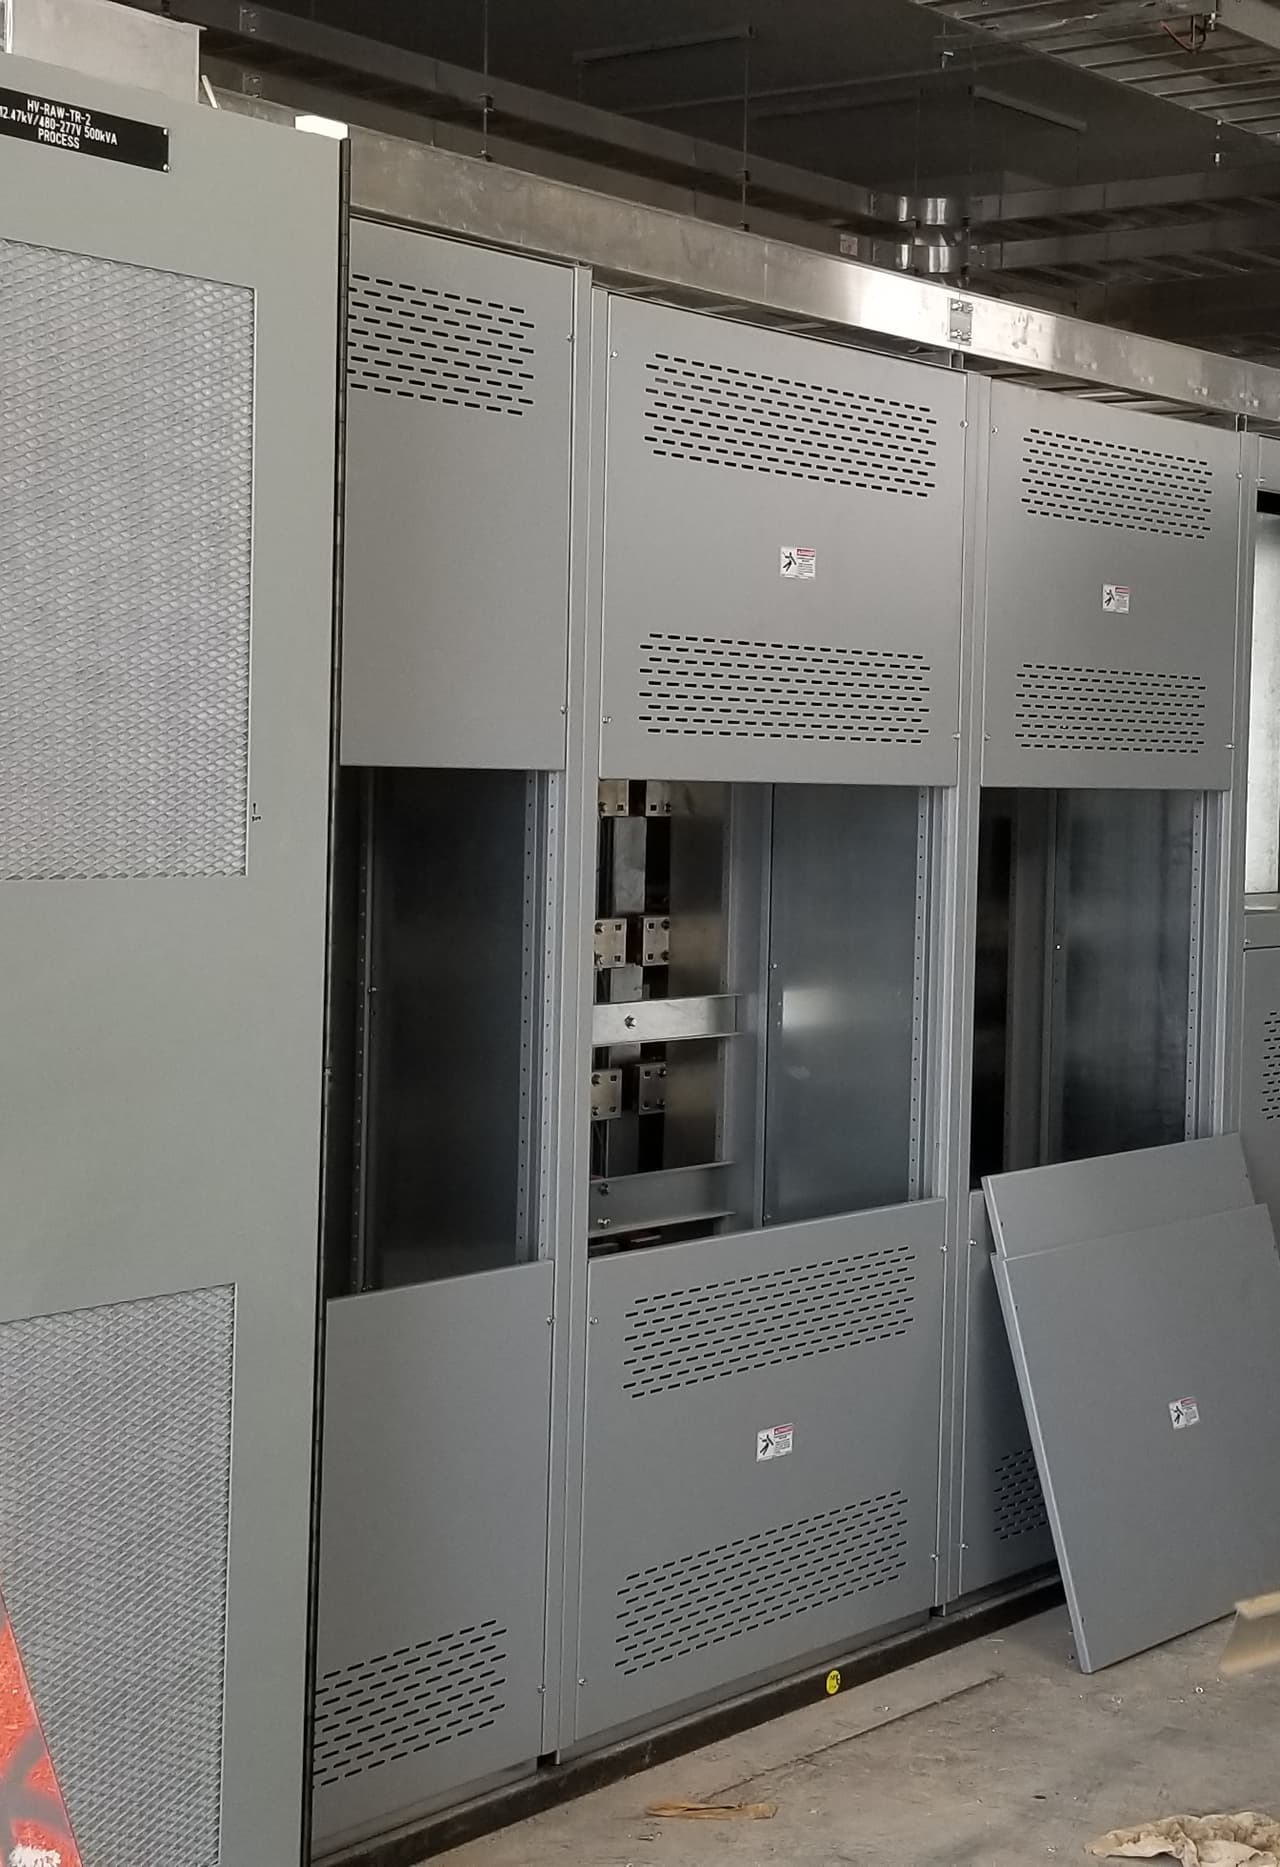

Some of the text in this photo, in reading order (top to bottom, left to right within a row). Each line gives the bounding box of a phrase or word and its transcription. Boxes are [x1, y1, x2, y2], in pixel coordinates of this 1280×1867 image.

[0, 105, 118, 145] 12.47kV/480-277V 500kVA
[27, 99, 91, 126] HV-RAW-TR-2
[38, 128, 80, 149] PROCESS
